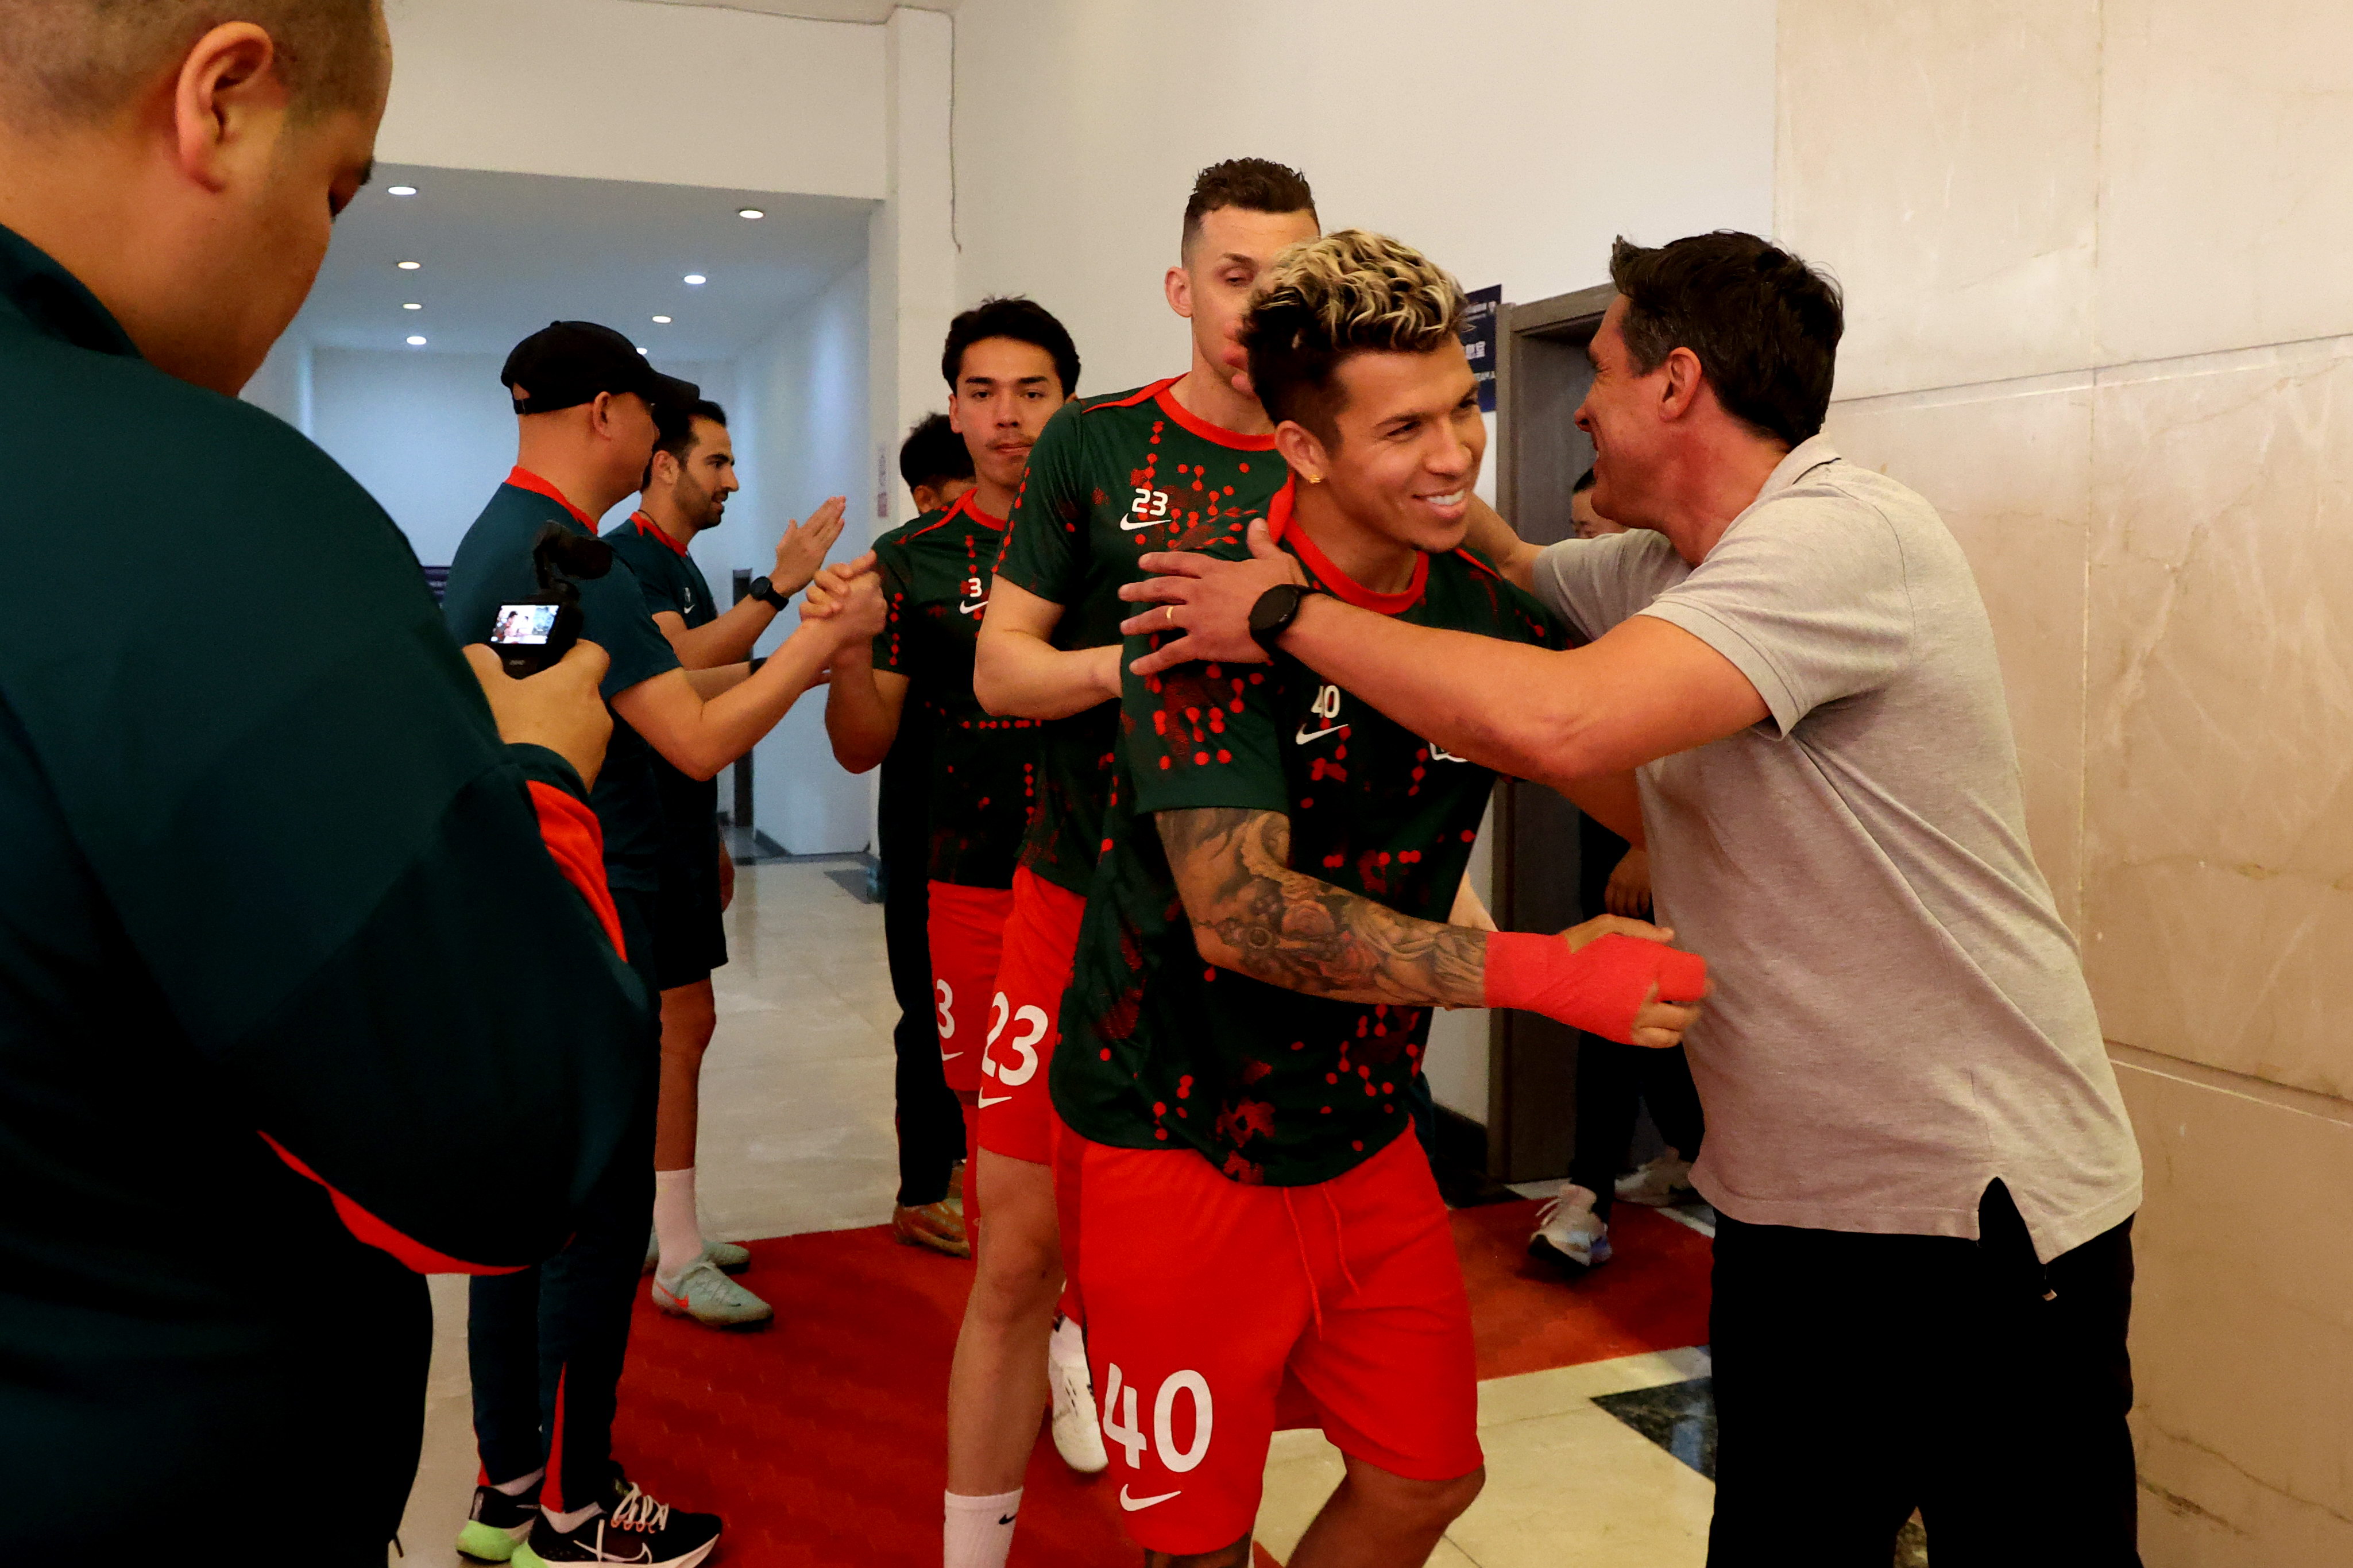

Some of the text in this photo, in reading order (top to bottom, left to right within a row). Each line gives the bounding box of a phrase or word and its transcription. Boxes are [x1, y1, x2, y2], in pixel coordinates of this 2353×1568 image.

[1132, 488, 1168, 516] 23
[968, 578, 982, 597] 3
[1311, 686, 1340, 718] 40
[937, 979, 955, 1039] 3
[982, 992, 1048, 1086] 23
[1103, 1362, 1213, 1473] 40
